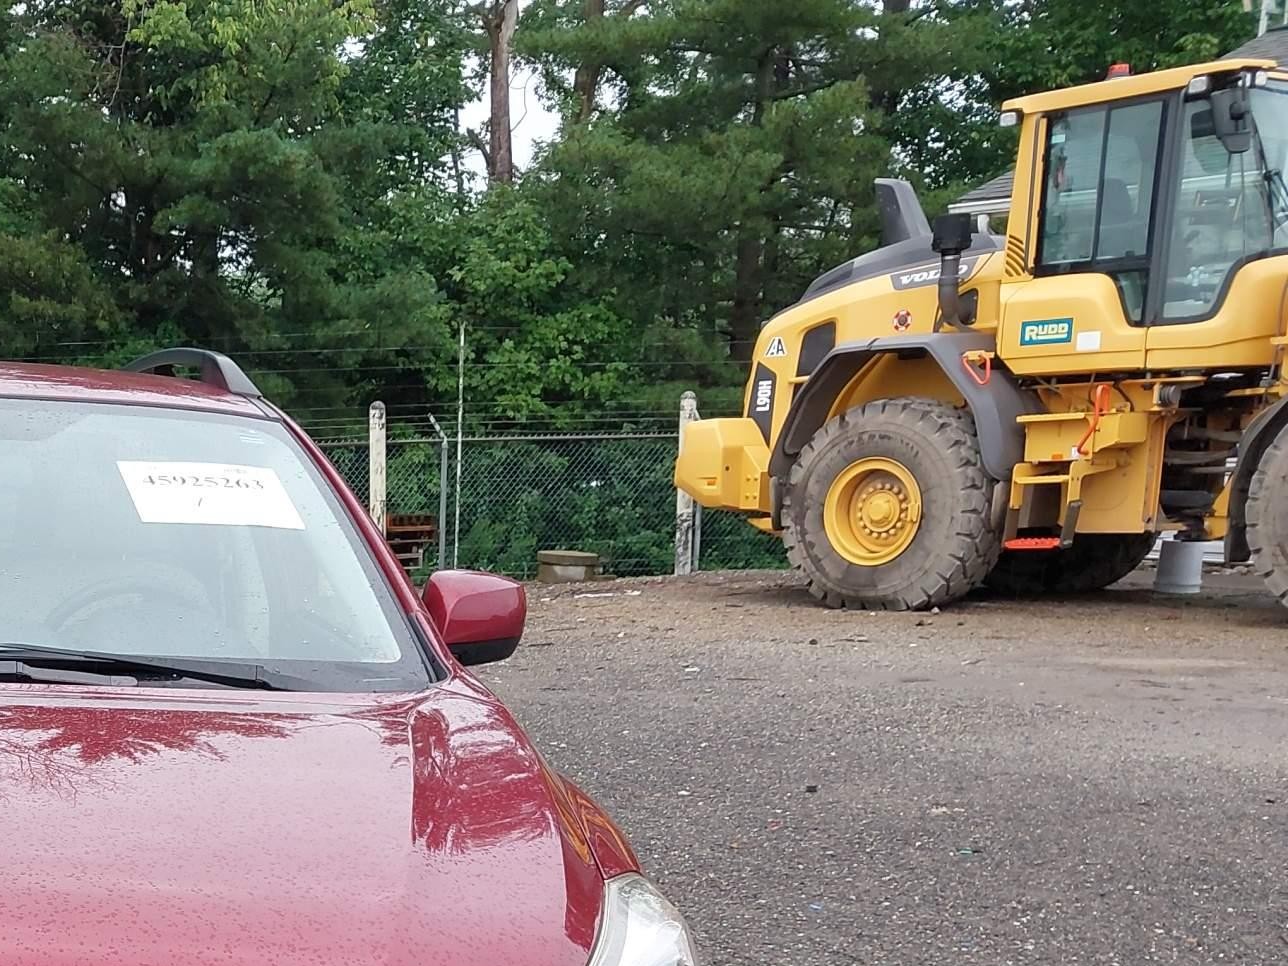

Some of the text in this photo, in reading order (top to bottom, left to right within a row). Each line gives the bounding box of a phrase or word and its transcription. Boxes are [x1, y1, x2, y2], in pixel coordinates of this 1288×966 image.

[900, 265, 968, 285] VOLO
[1025, 323, 1069, 341] RUDD
[756, 380, 772, 412] L90H
[143, 475, 264, 489] 45925263
